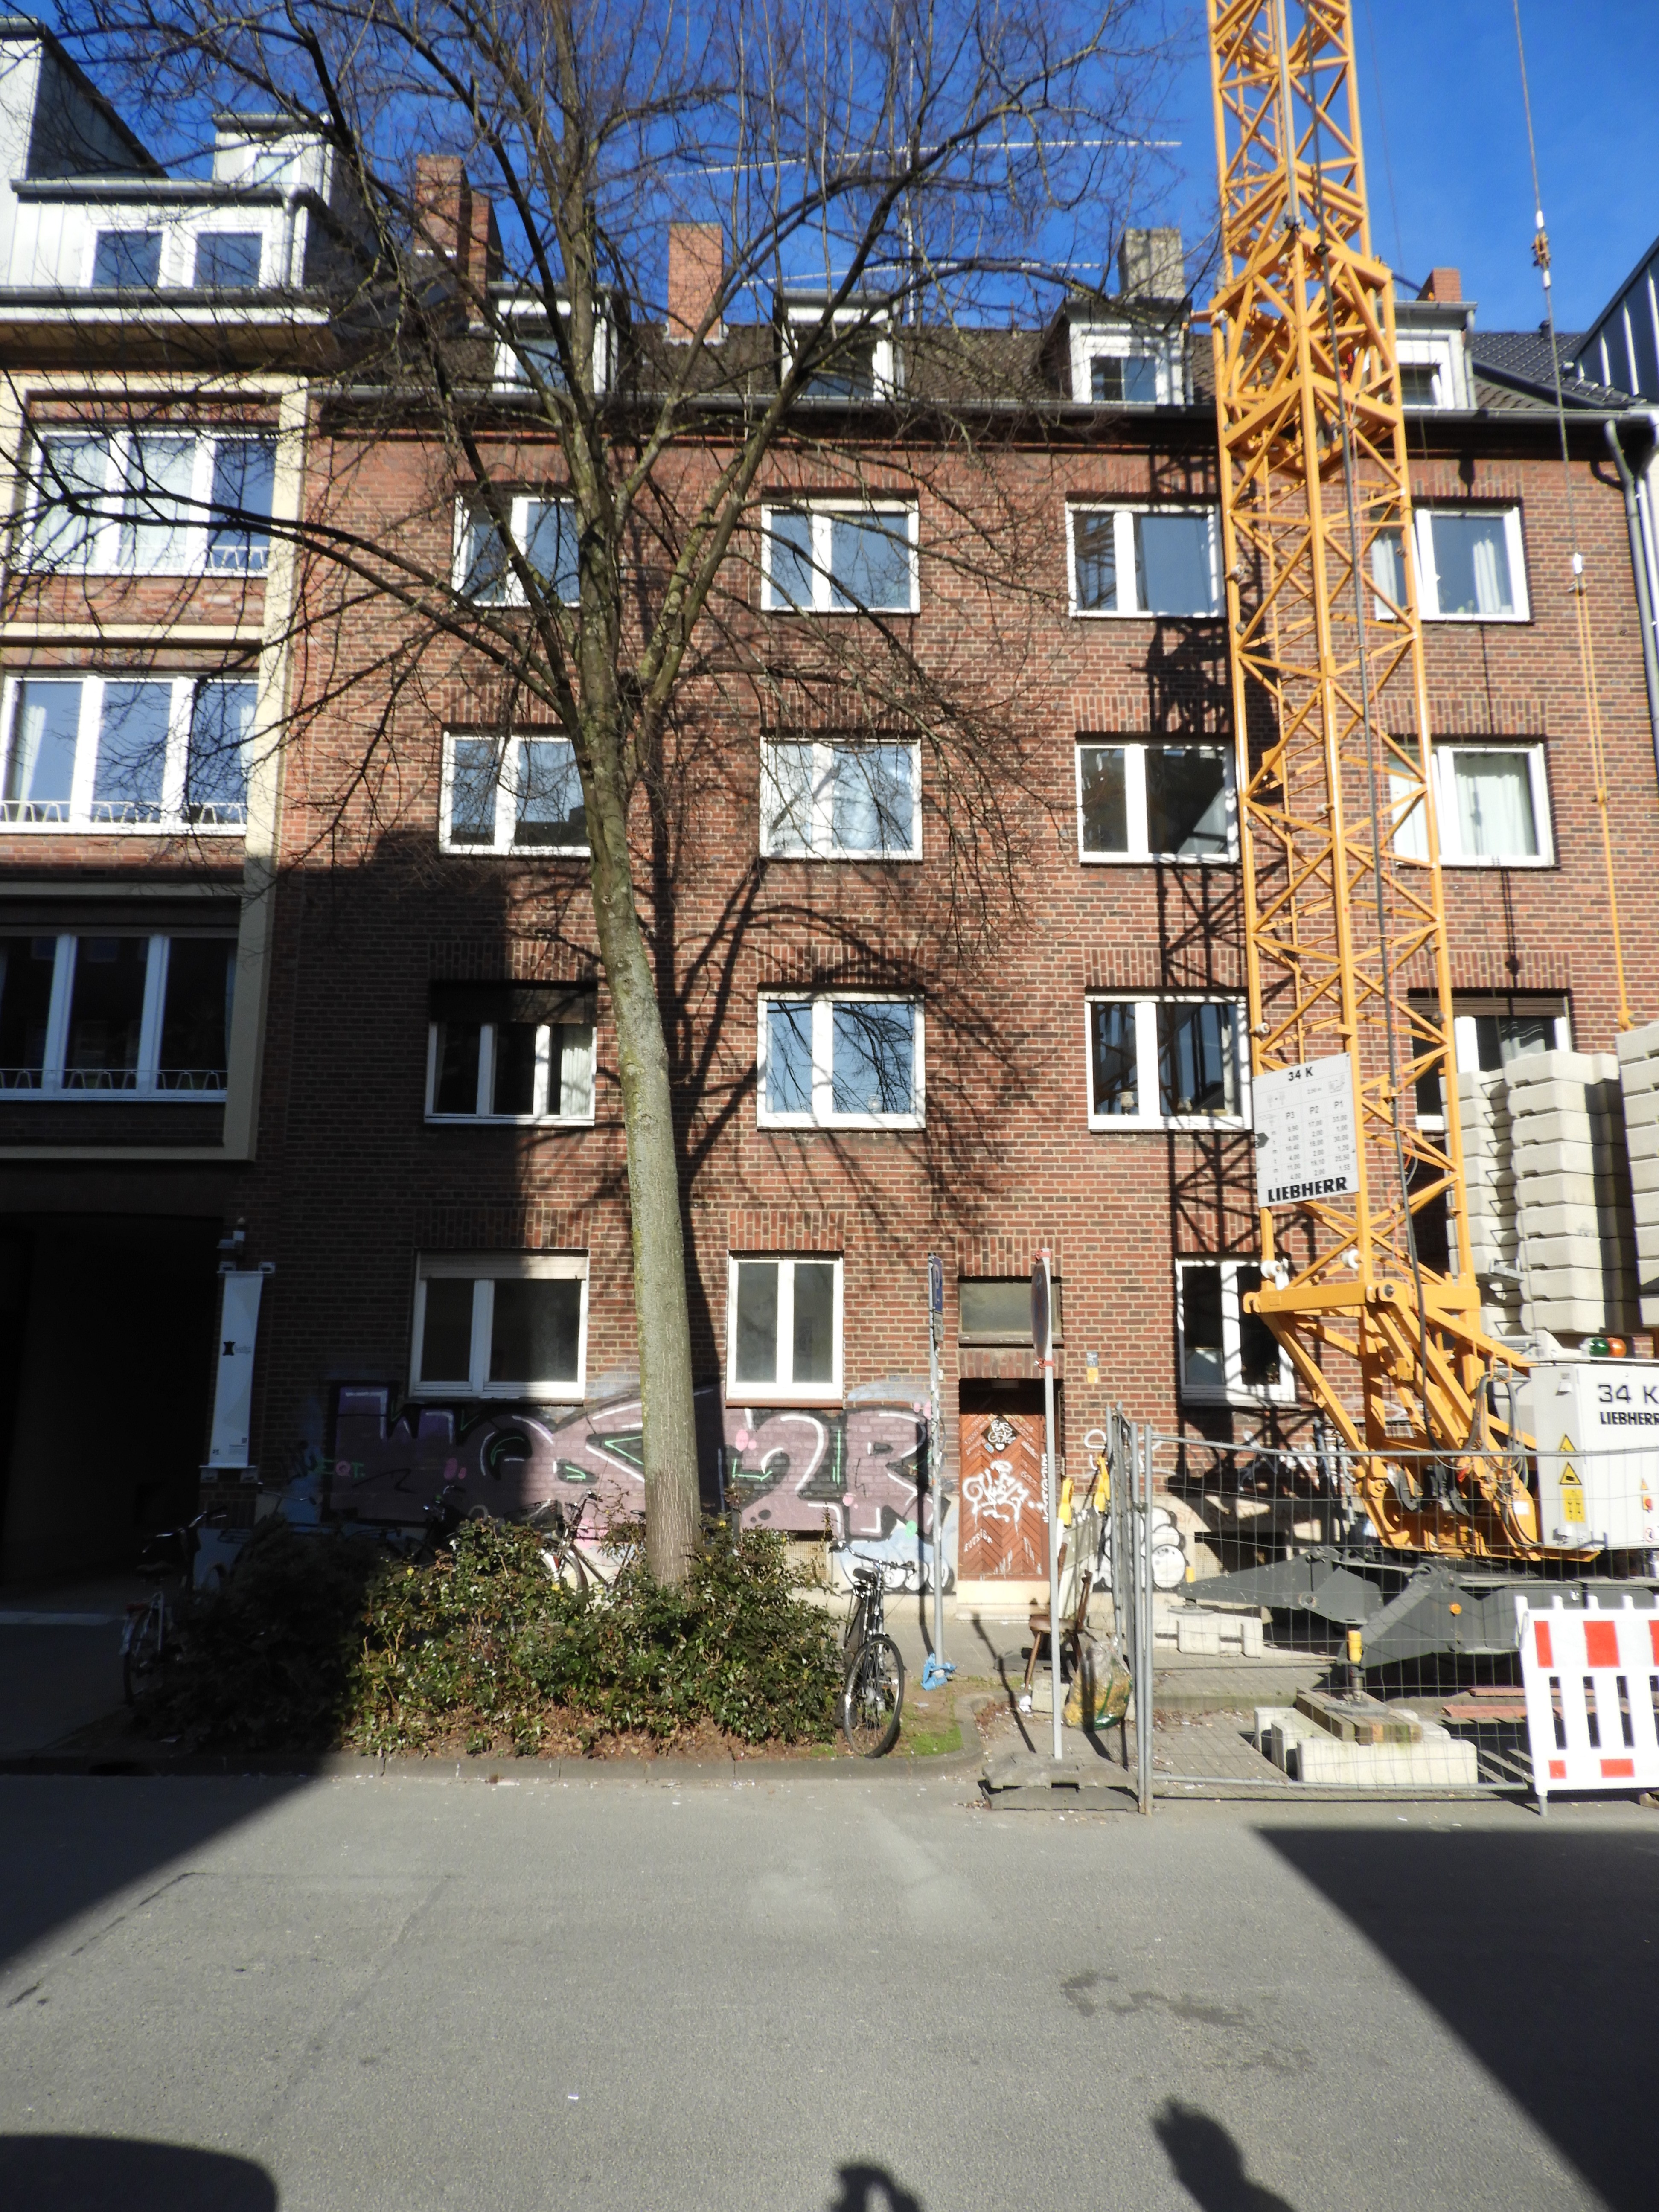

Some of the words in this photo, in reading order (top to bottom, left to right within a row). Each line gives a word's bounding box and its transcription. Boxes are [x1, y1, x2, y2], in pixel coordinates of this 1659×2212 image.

[1288, 1070, 1301, 1081] 34
[1306, 1067, 1313, 1077] K
[1268, 1176, 1348, 1202] LIEBHERR
[1598, 1384, 1631, 1403] 34
[1643, 1386, 1659, 1404] K
[1600, 1412, 1659, 1425] LIEBHERR
